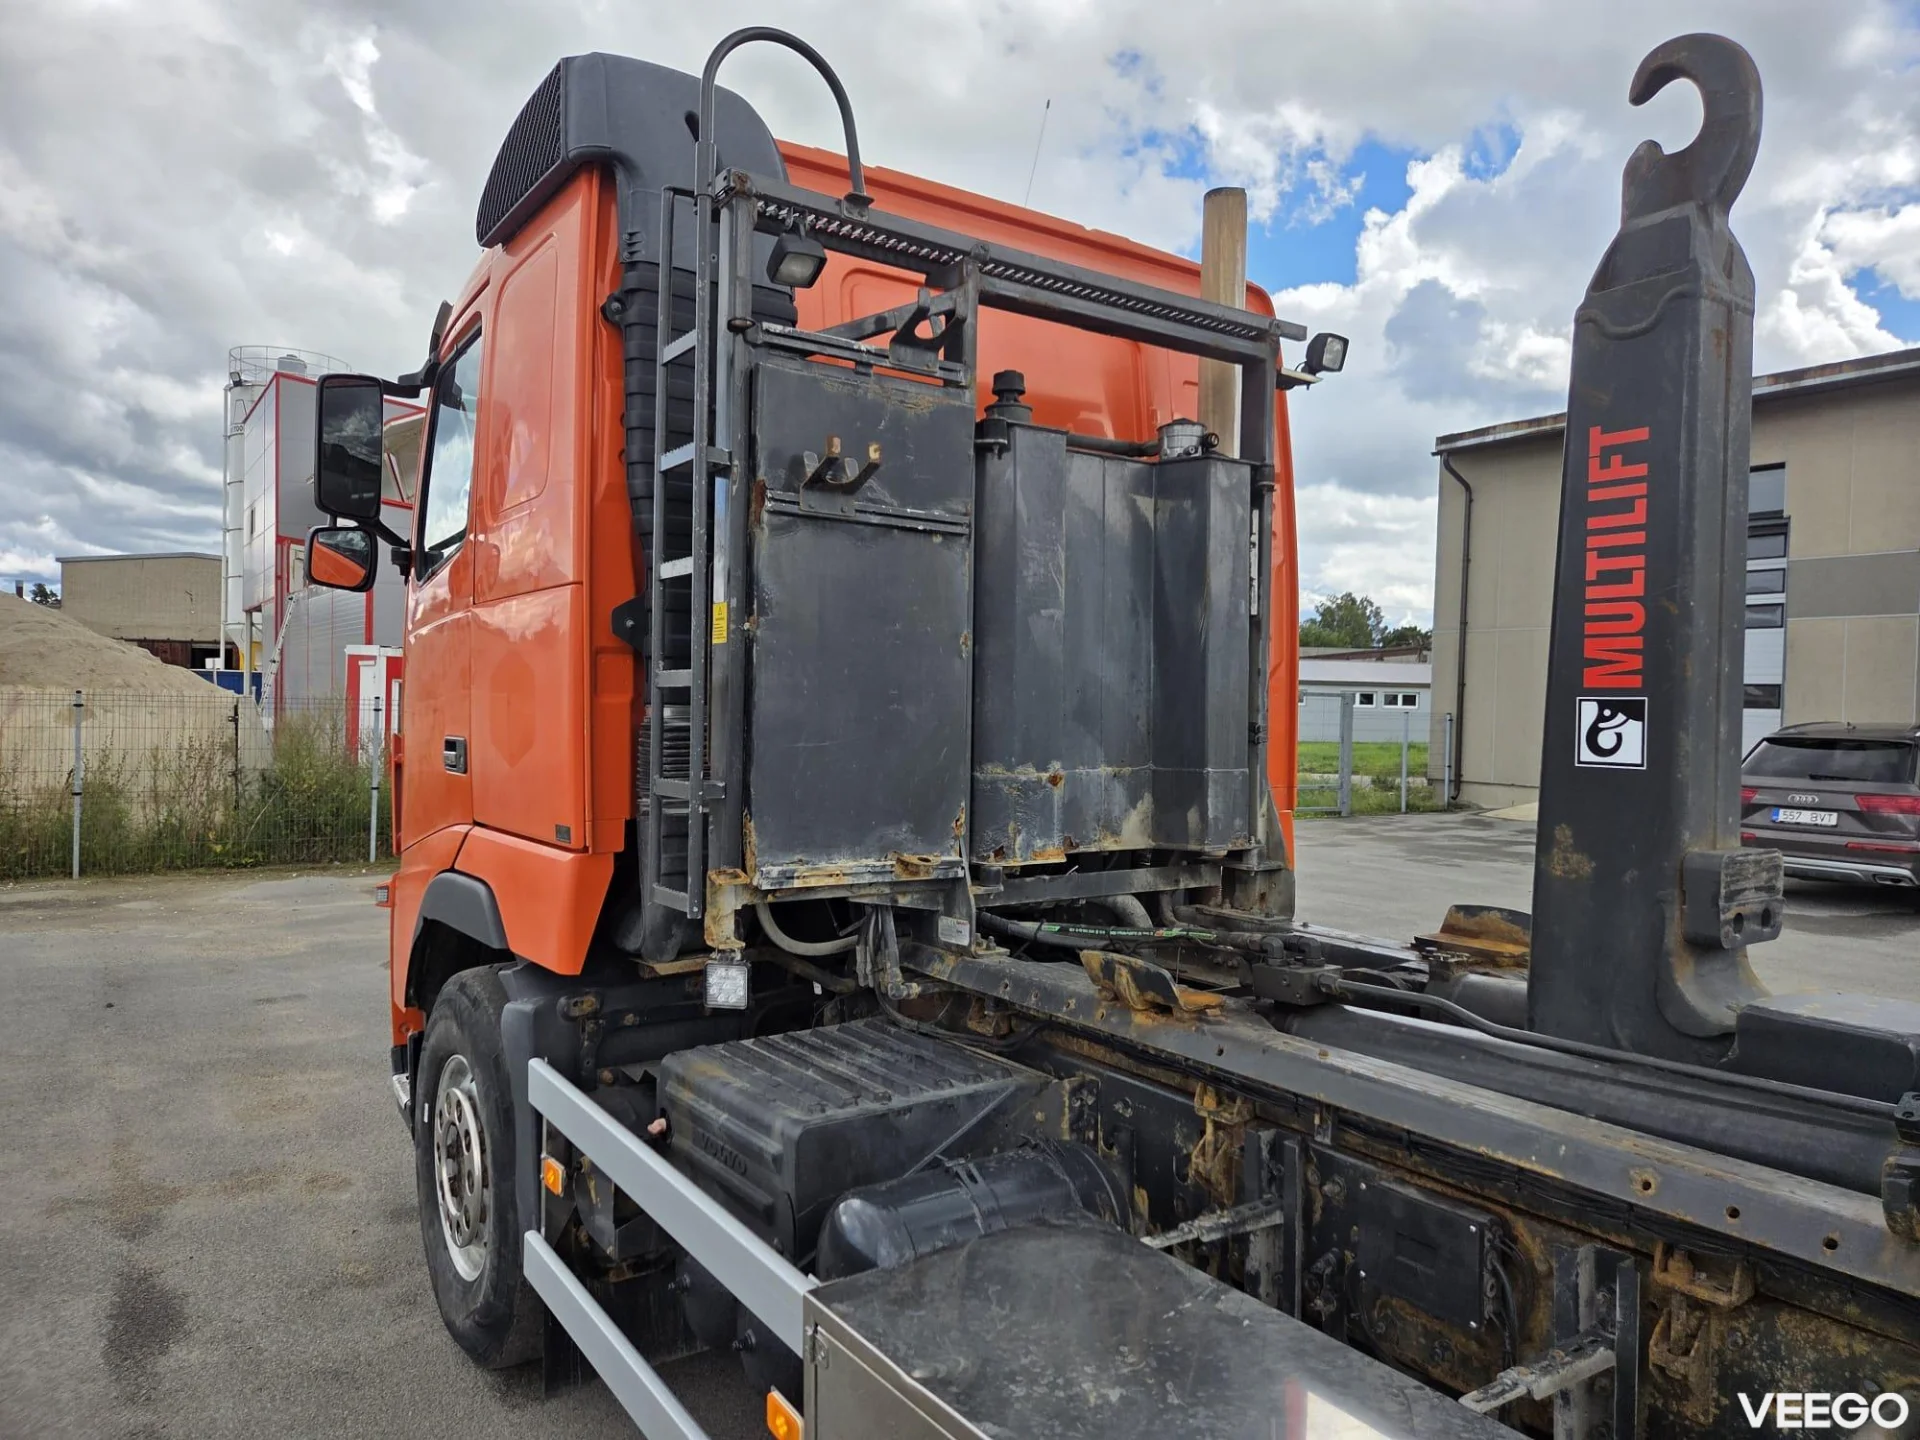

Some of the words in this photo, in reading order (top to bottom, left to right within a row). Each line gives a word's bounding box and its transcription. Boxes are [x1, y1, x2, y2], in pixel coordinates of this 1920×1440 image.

[1583, 426, 1650, 688] MULTILIFT
[1782, 810, 1802, 820] 557
[1810, 812, 1833, 822] BVT
